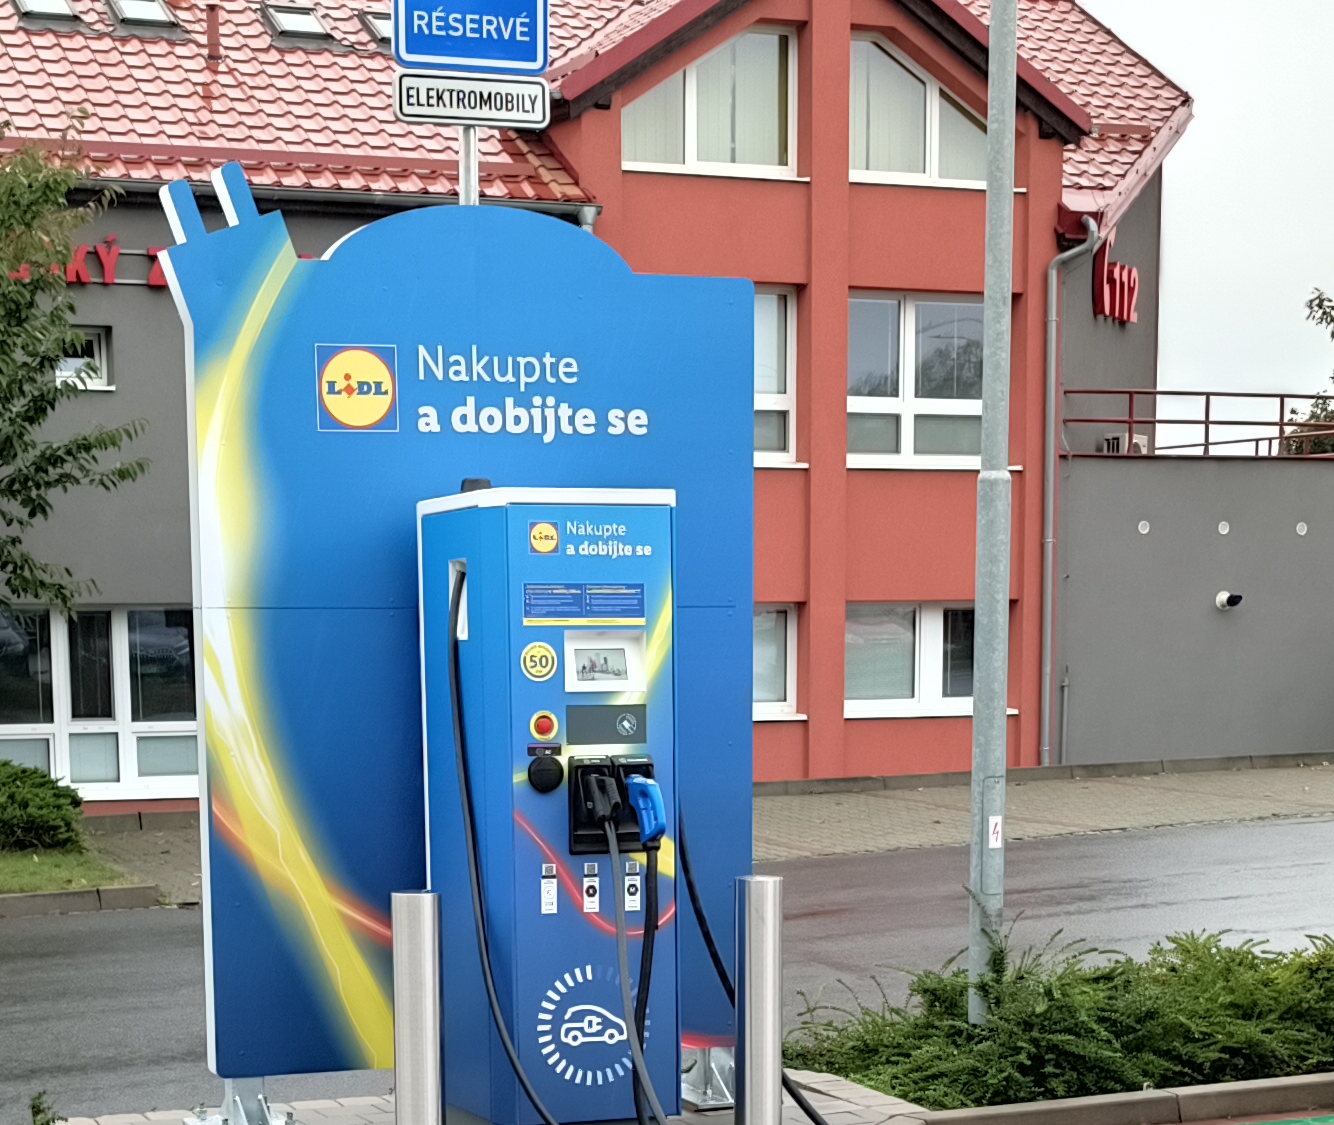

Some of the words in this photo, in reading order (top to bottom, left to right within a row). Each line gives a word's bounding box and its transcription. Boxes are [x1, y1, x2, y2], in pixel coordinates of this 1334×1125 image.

[413, 6, 530, 42] RÉSERVÉ
[406, 86, 539, 114] ELEKTROMOBILY
[1112, 261, 1139, 323] 112
[417, 344, 579, 392] Nakupte
[417, 405, 441, 433] a
[451, 396, 596, 444] dobijte
[607, 407, 649, 435] se
[566, 520, 627, 539] Nakupte
[565, 544, 576, 556] a
[579, 540, 633, 560] dobijte
[635, 545, 653, 556] se
[529, 654, 550, 669] 50
